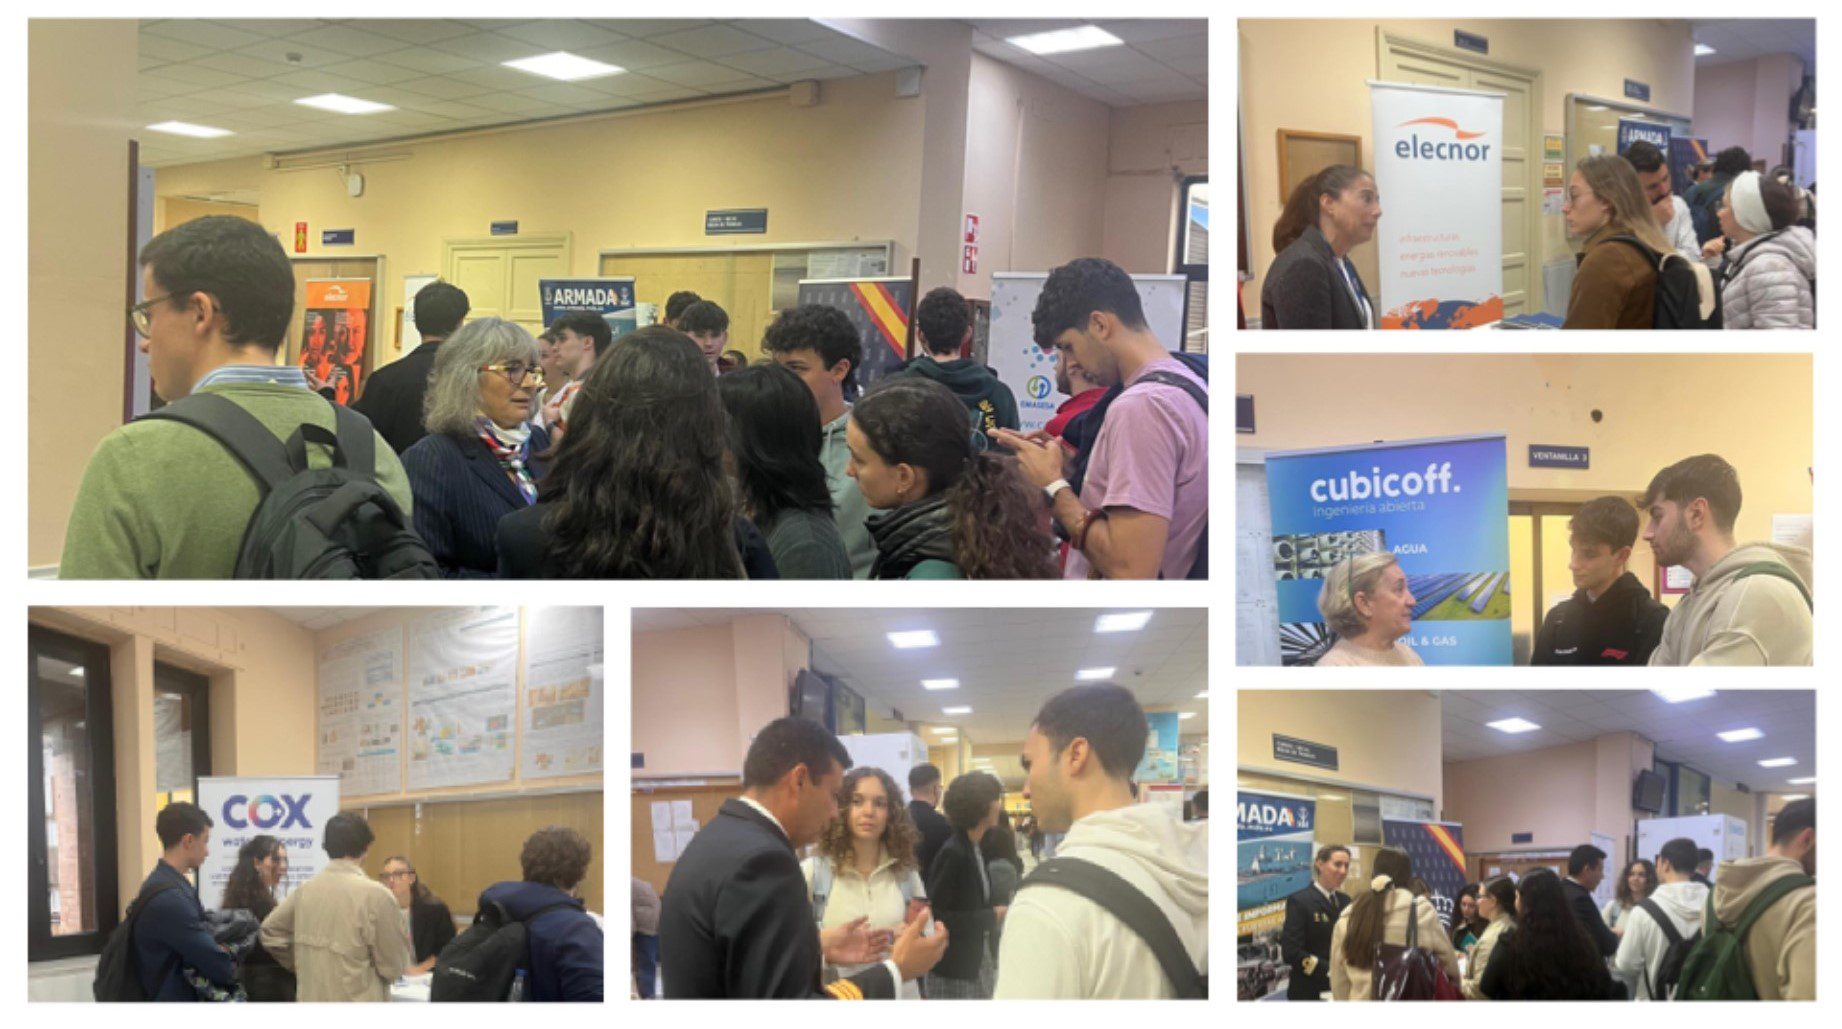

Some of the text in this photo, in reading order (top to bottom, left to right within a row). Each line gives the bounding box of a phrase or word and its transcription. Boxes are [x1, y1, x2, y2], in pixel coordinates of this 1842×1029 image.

[1395, 133, 1490, 160] elecnor
[554, 288, 616, 305] ARMADA
[1532, 451, 1579, 461] VENTANILLA
[1310, 461, 1461, 503] cubicoff.
[1379, 499, 1425, 513] abierta
[1393, 543, 1428, 554] AGUA
[1432, 635, 1457, 647] GAS
[222, 793, 312, 830] COX
